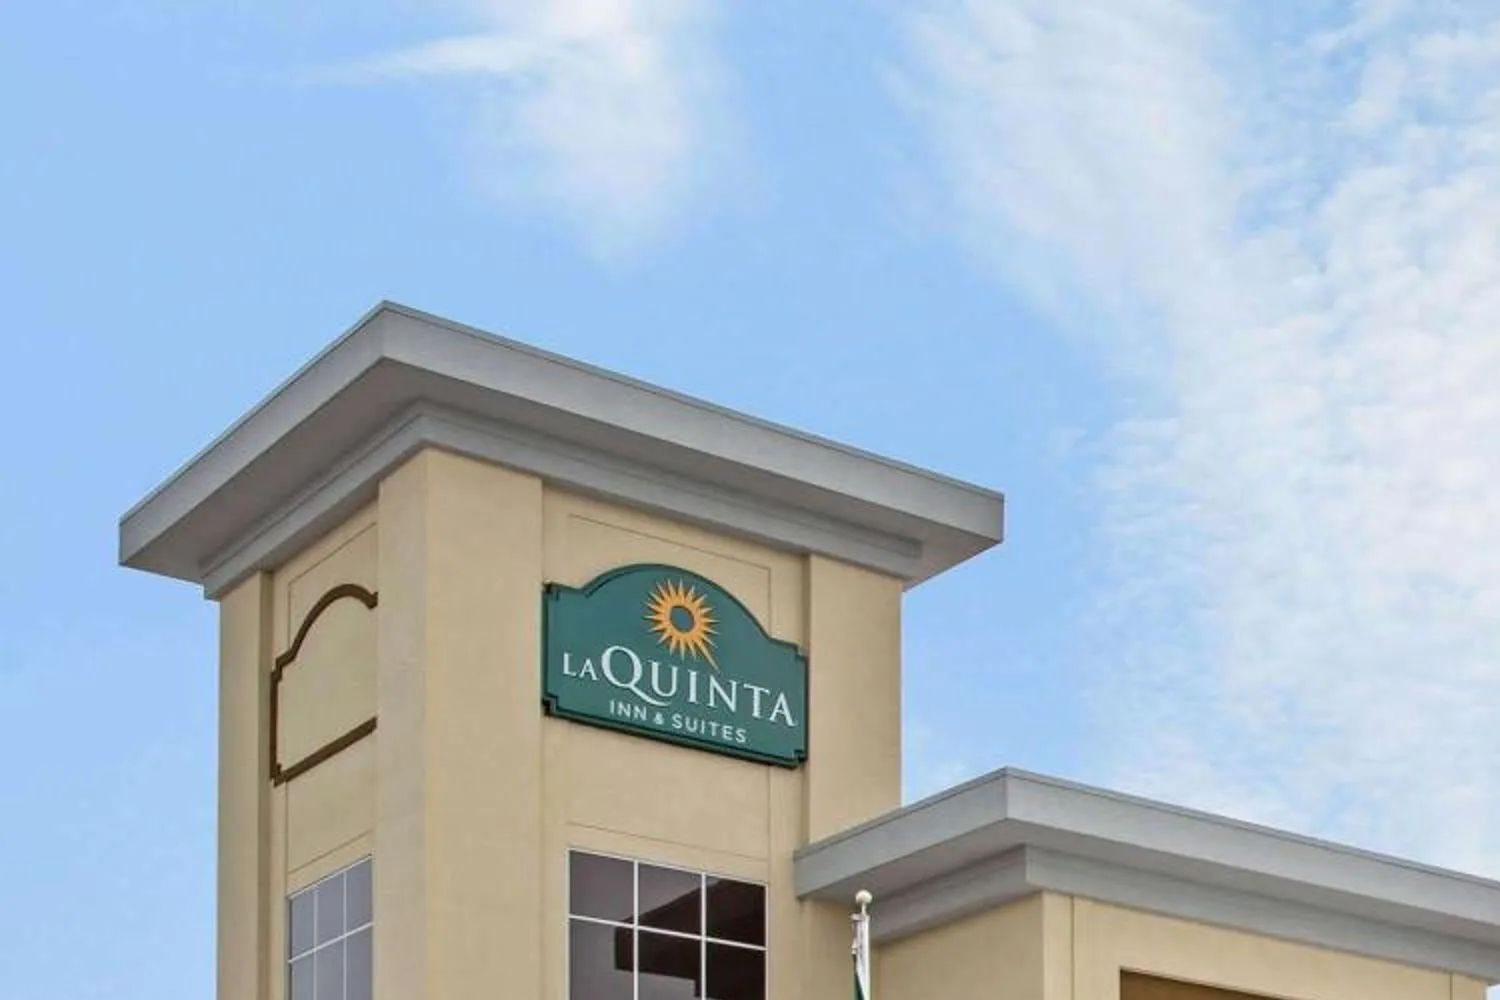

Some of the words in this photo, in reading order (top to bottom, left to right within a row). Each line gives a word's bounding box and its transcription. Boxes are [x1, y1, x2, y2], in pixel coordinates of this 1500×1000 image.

[562, 652, 599, 681] LA
[601, 645, 797, 727] QUINTA
[609, 700, 647, 721] INN
[654, 711, 664, 725] &
[672, 713, 747, 743] SUITES
